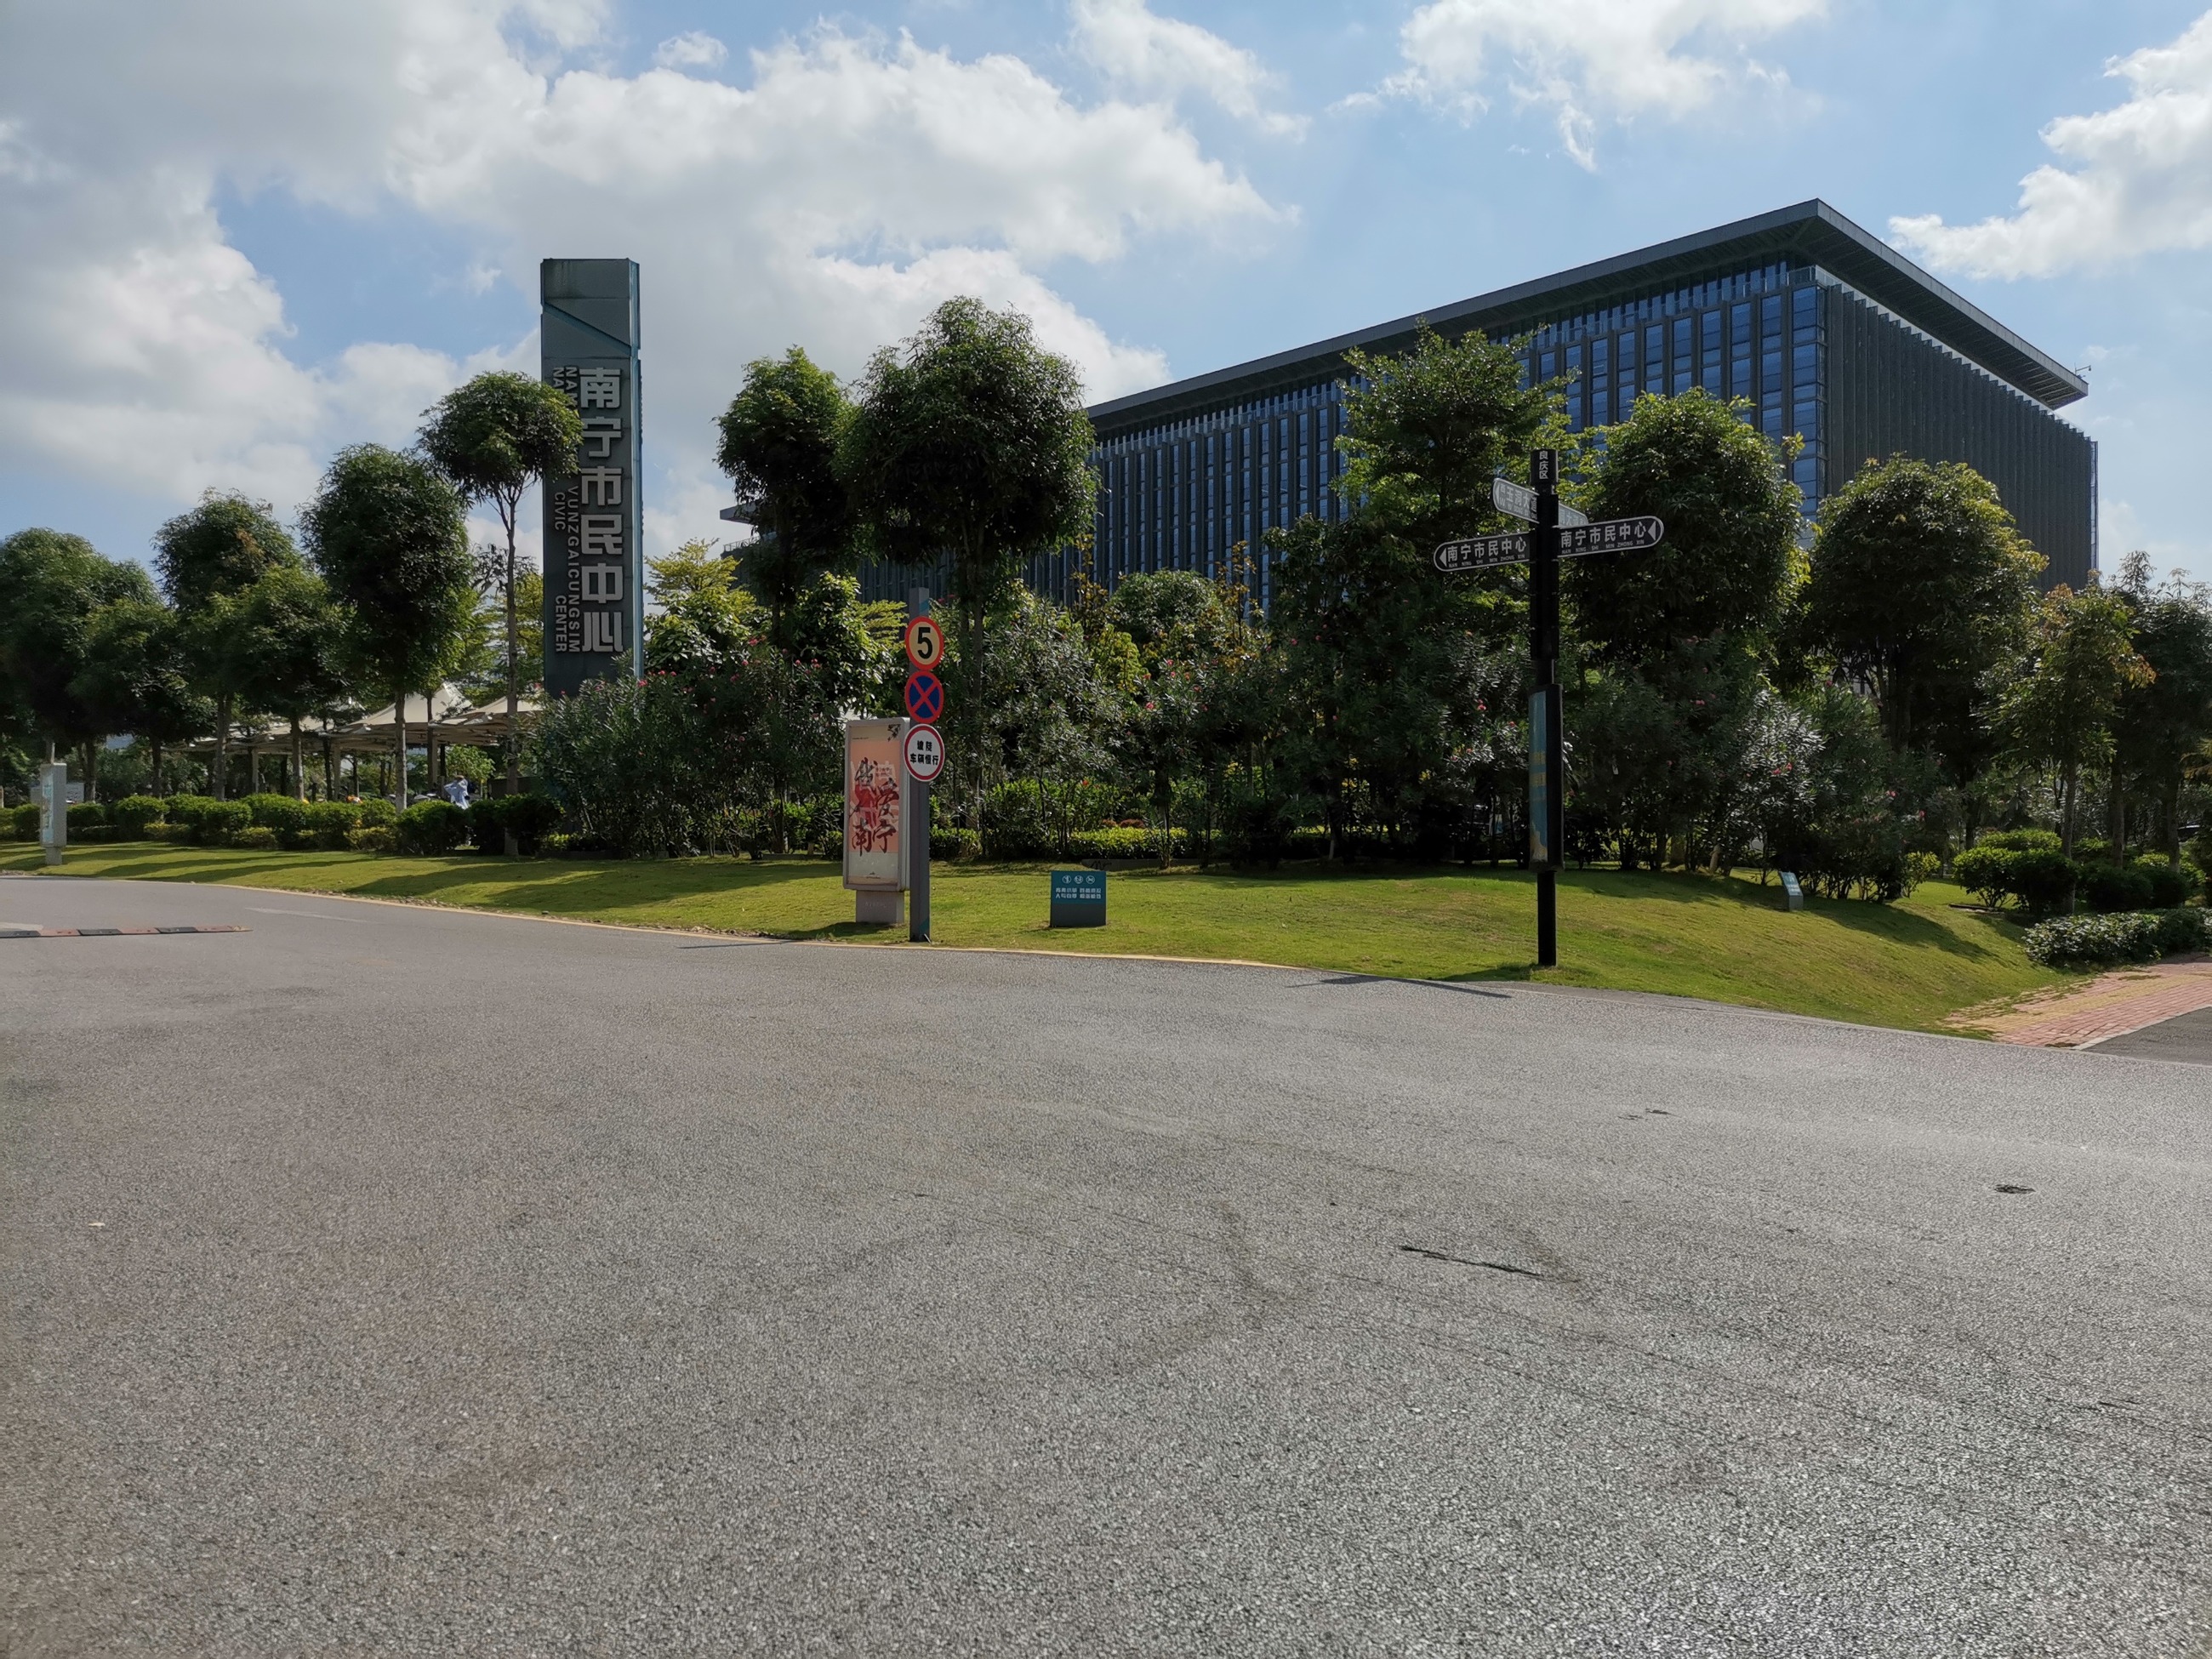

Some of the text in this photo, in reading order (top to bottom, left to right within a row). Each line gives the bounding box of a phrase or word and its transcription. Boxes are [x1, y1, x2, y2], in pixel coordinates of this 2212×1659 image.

[1538, 450, 1548, 480] 良庆区
[579, 367, 624, 653] 南宁市民中心
[1446, 536, 1527, 562] 南宁市民中心
[1559, 520, 1647, 549] 南宁市民中心
[554, 491, 567, 653] CIVIC CENTER
[567, 485, 581, 653] VUNZGAICUNGSIM
[916, 625, 933, 659] 5
[909, 753, 938, 766] 车辆慢行
